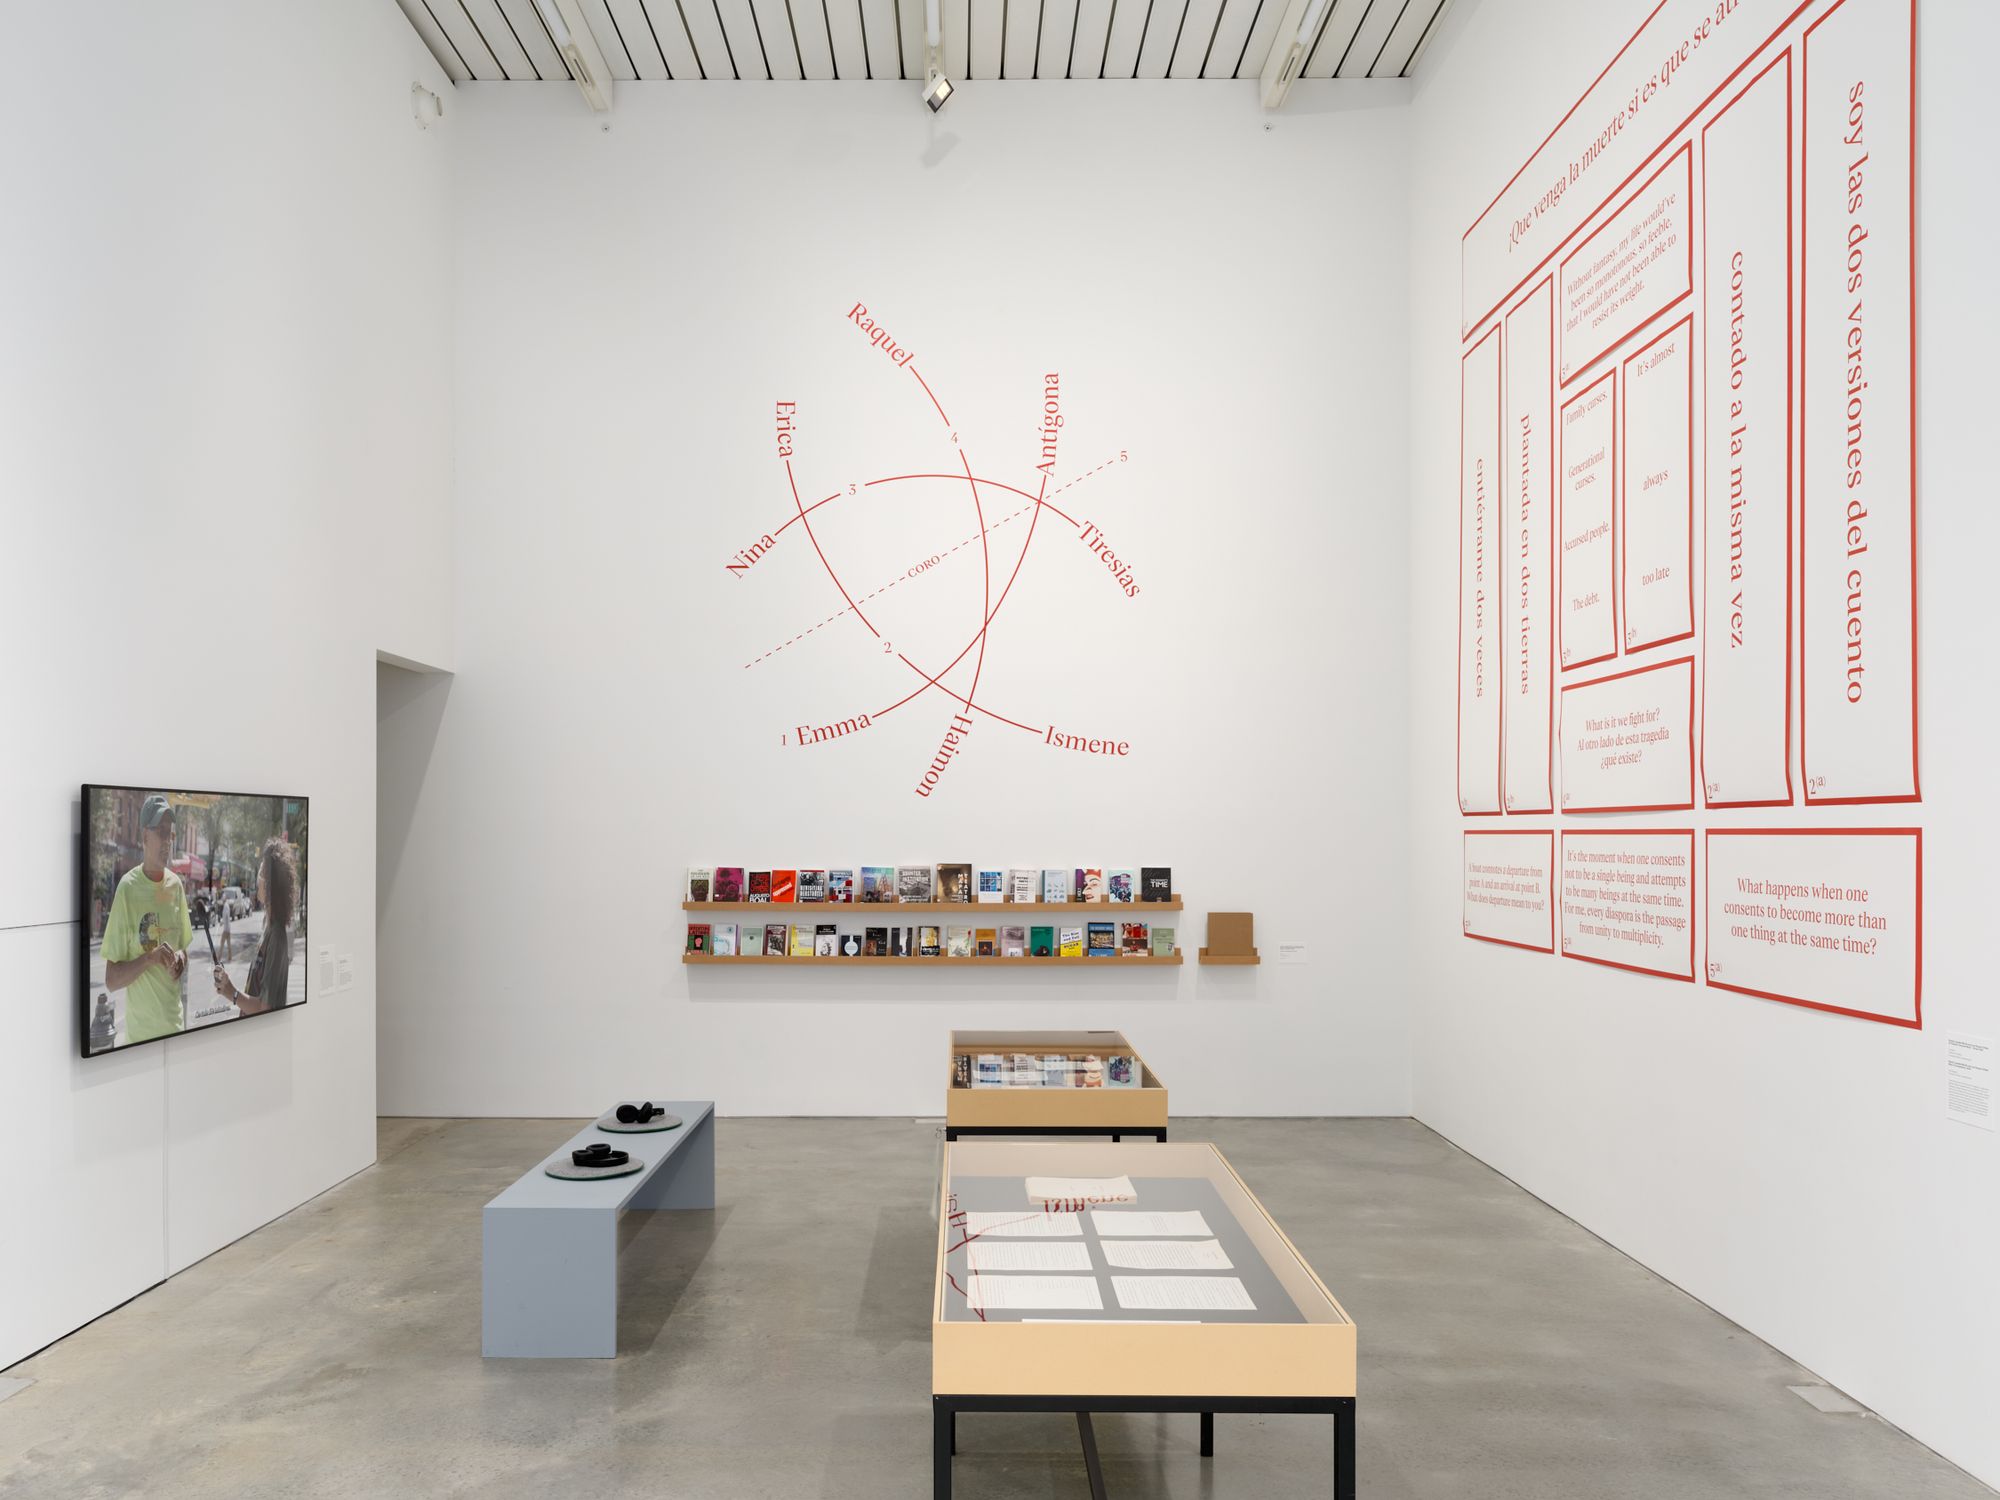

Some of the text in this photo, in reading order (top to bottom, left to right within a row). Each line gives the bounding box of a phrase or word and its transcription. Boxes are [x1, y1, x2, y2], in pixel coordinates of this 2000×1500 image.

[1509, 17, 1710, 253] ¡Que venga la muerte si es que se
[1568, 265, 1593, 296] Without
[1619, 236, 1629, 253] my
[1631, 223, 1641, 241] life
[1642, 193, 1676, 228] would've
[1567, 233, 1676, 332] that would have not been able to
[1571, 240, 1646, 311] been so so
[1592, 281, 1645, 328] resist its weight.
[846, 301, 915, 368] Raquel
[1637, 342, 1676, 377] It's almost
[1844, 81, 1869, 703] soy las dos versiones del cuento
[776, 400, 796, 458] Erica
[1036, 373, 1063, 477] Antígona
[1567, 404, 1586, 425] Family
[950, 432, 959, 444] 4
[1730, 251, 1747, 649] contado a la misma vez
[1120, 450, 1128, 462] 5
[1569, 447, 1605, 478] Generational
[849, 484, 857, 496] 3
[1643, 469, 1669, 490] always
[1476, 458, 1486, 582] entiérrame
[1564, 521, 1610, 551] Accursed people.
[726, 533, 777, 579] Nina
[907, 555, 941, 578] CORO
[1076, 521, 1141, 597] Tiresias
[1521, 414, 1531, 695] plantada en dos tierras
[1642, 567, 1670, 586] too late
[1476, 589, 1485, 628] dos
[1572, 592, 1600, 611] The debt.
[884, 642, 892, 653] 2
[796, 713, 872, 747] Emma
[1586, 707, 1660, 732] What is it we fight for?
[1043, 725, 1130, 757] Ismene
[1577, 727, 1669, 751] Al otro lado de esta tragedia
[915, 714, 973, 797] Haimon
[1601, 750, 1642, 769] ¿qué existe?
[1507, 865, 1529, 878] departure
[1568, 850, 1685, 866] It's the moment when one consents
[1485, 880, 1534, 895] and an arrival at point
[1565, 869, 1575, 879] not
[1576, 870, 1582, 879] to
[1583, 868, 1590, 880] be
[1597, 869, 1616, 885] single
[1617, 870, 1634, 886] being
[1636, 872, 1649, 884] and
[1651, 873, 1686, 889] attempts
[1738, 878, 1868, 902] What happens when one
[1467, 891, 1544, 912] What does departure mean to you?
[1566, 885, 1684, 907] to be many beings at the same time.
[1565, 902, 1686, 931] For me, every diaspora is the passage
[1724, 902, 1886, 930] consents to become more than
[1580, 921, 1664, 948] from unity to multiplicity.
[1731, 925, 1876, 955] one thing at the same time?
